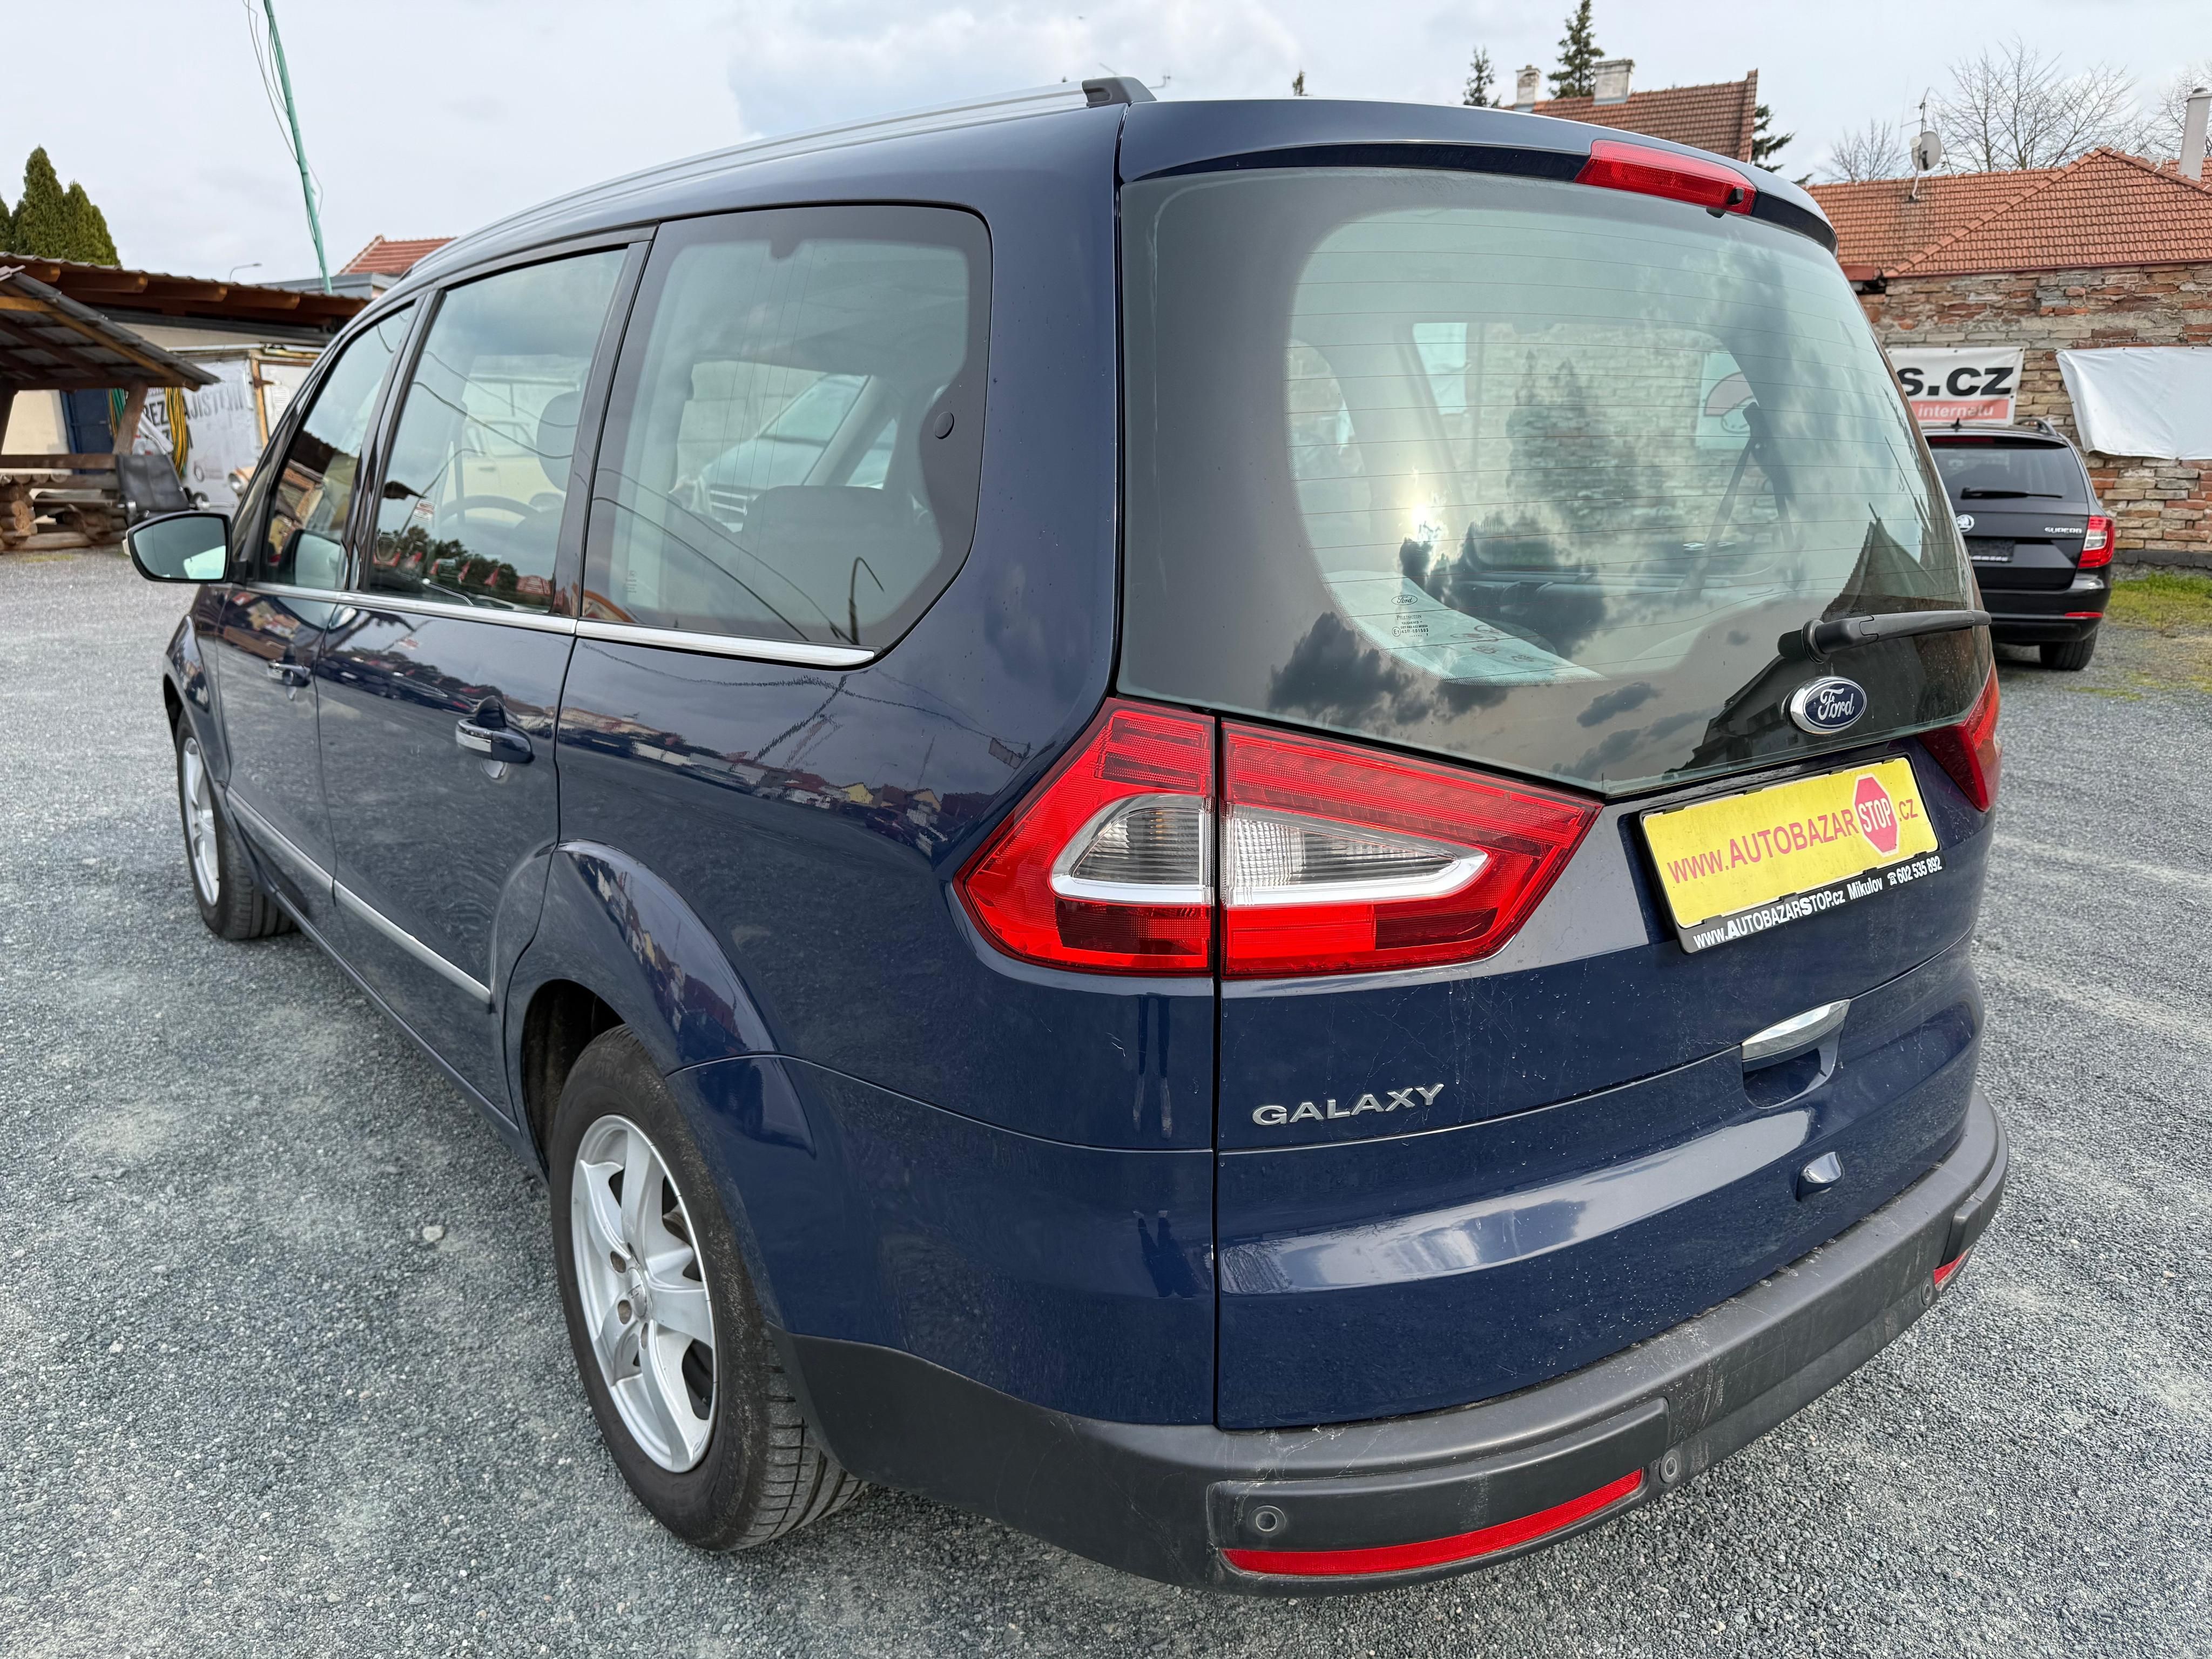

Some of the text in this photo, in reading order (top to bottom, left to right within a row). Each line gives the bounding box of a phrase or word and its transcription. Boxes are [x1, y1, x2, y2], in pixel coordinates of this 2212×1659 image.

[1918, 404, 1995, 417] internetu
[1397, 596, 1413, 604] Ford
[1817, 687, 1854, 720] Ford
[1858, 797, 1892, 833] STOP
[1846, 877, 1883, 900] Mikulov
[1896, 865, 1913, 884] 602
[1911, 860, 1927, 878] 535
[1926, 855, 1943, 873] 892
[1252, 1083, 1445, 1125] GALAXY
